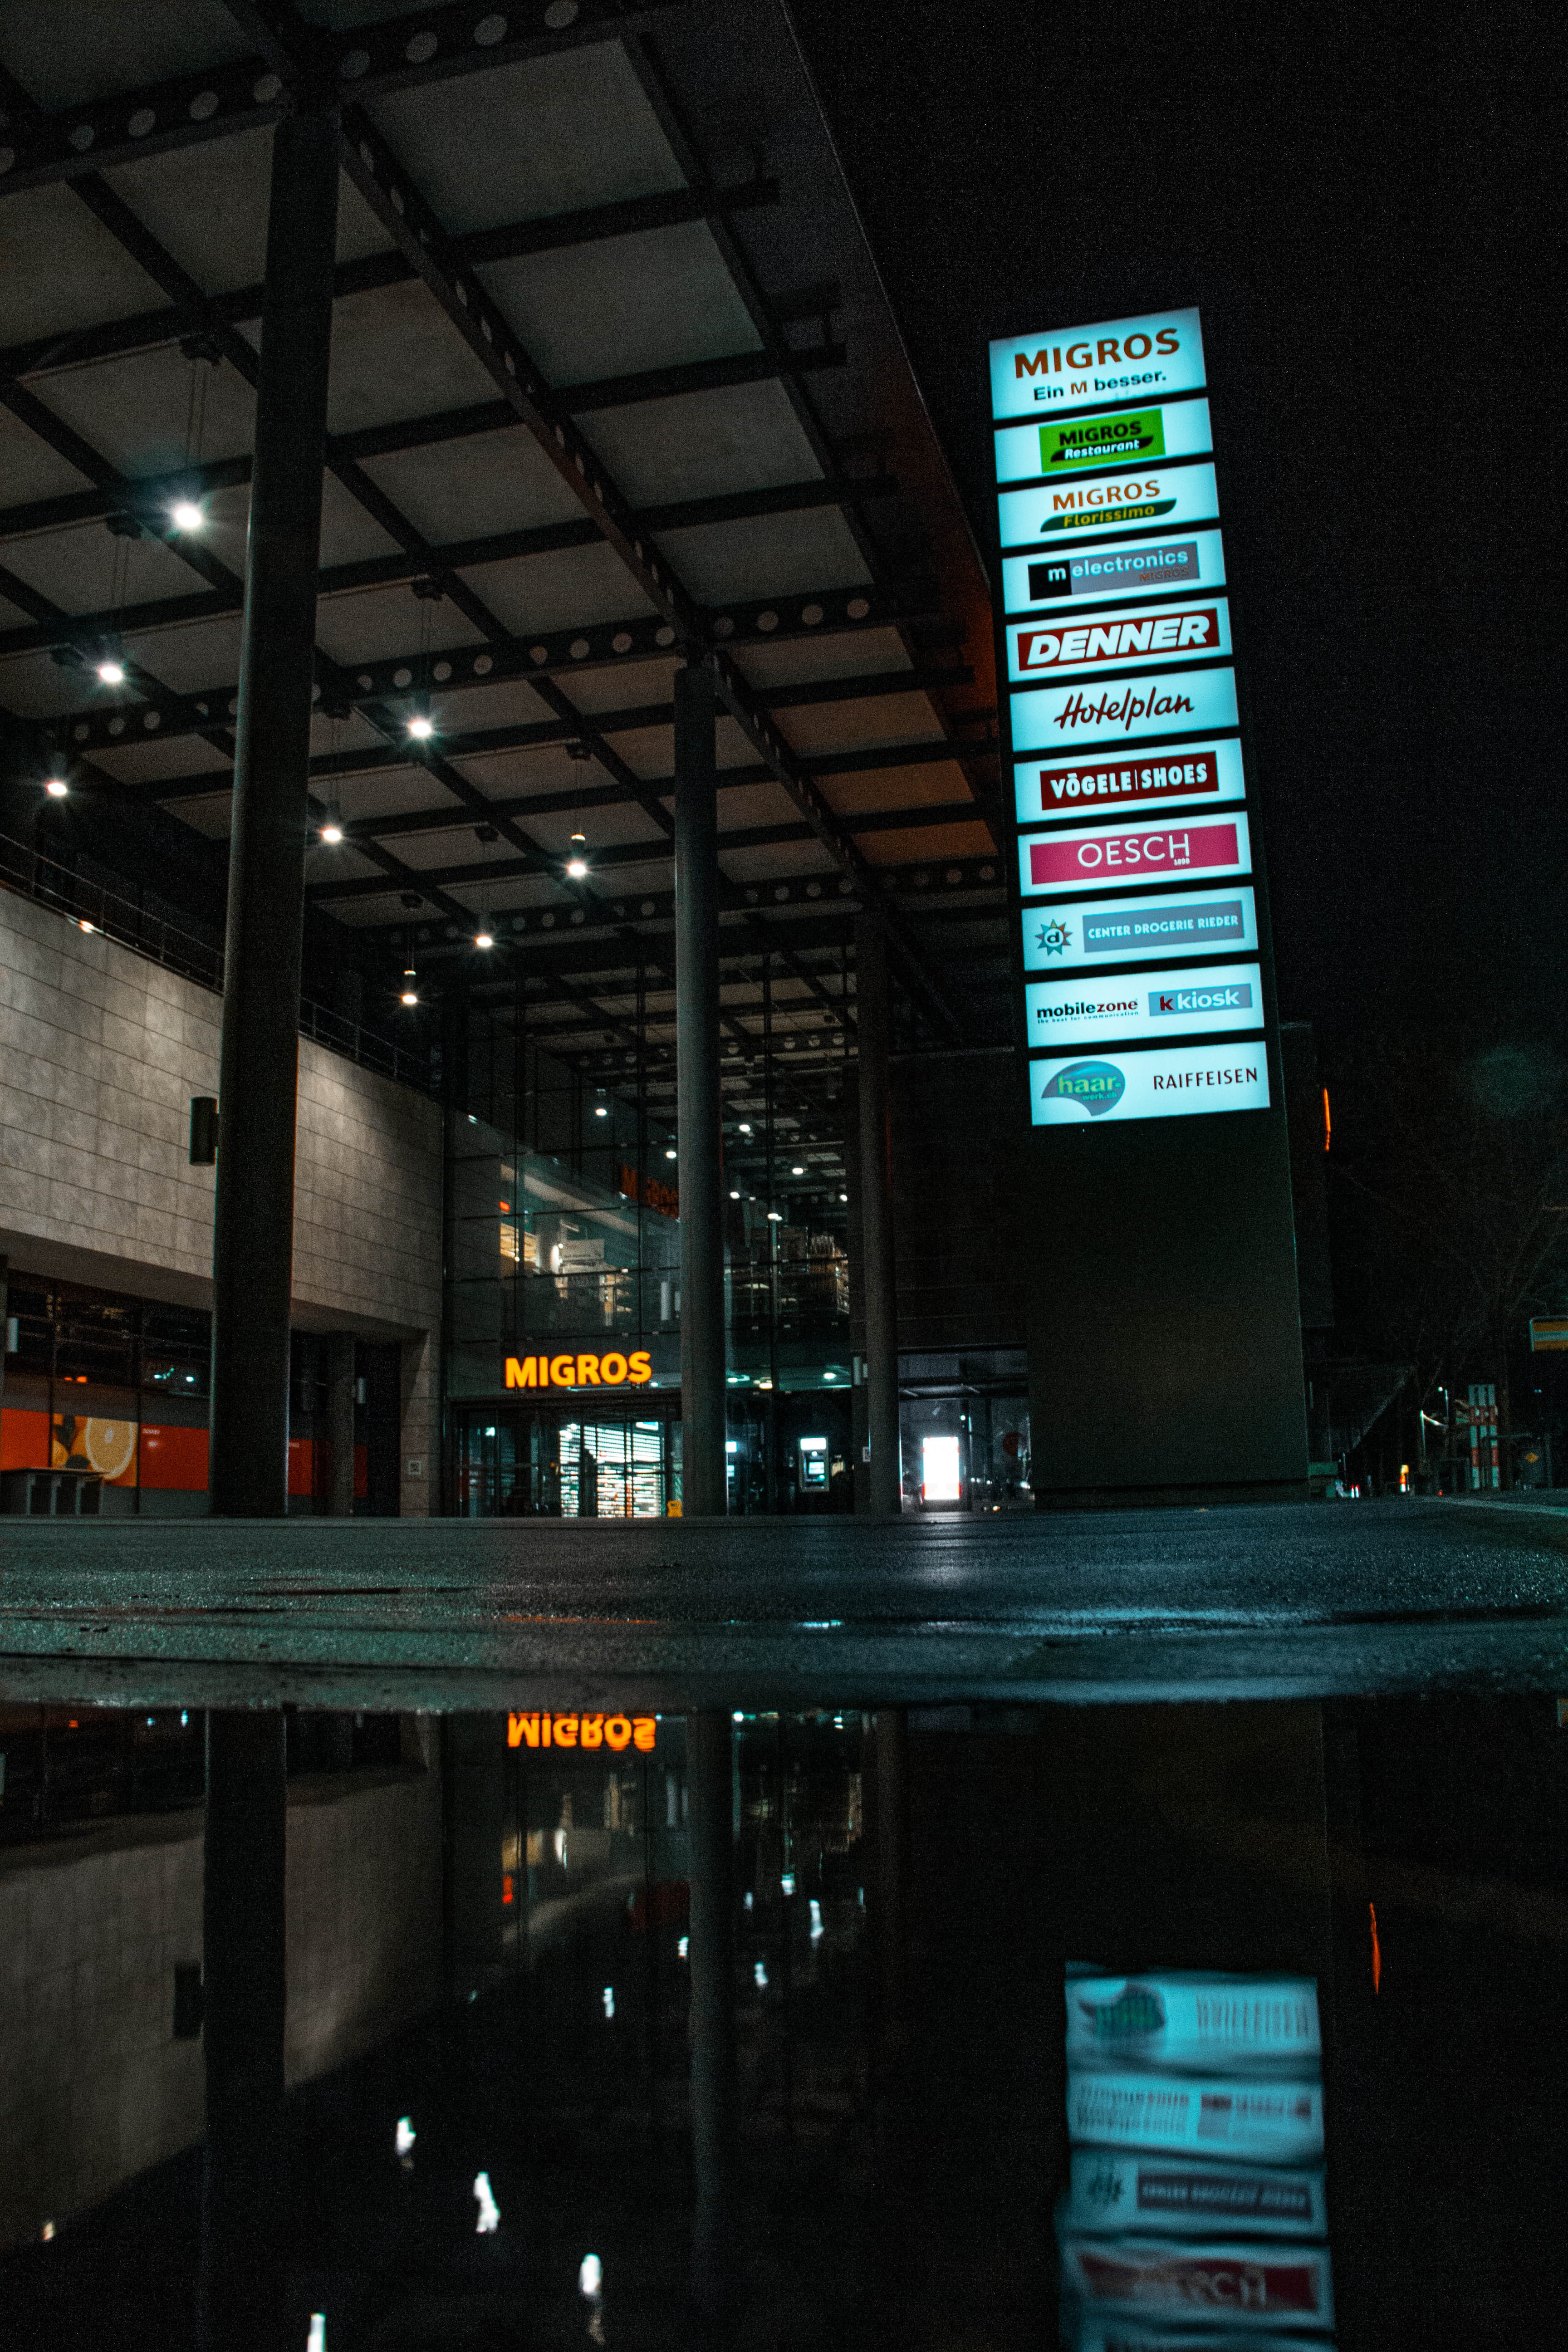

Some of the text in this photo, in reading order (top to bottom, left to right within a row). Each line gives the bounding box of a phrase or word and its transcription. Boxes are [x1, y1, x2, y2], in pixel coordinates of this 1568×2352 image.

[1014, 328, 1180, 378] MIGROS
[1034, 370, 1166, 401] Ein M besser.
[1059, 421, 1142, 446] MIGROS
[1064, 439, 1140, 460] Restaurant
[1053, 480, 1160, 510] MIGROS
[1063, 505, 1155, 528] Florissimo
[1140, 567, 1189, 580] MIGROS
[1027, 615, 1210, 665] DENNER
[1053, 686, 1195, 731] Hotelplan
[1141, 763, 1208, 789] SHOES
[1078, 833, 1190, 868] OESCH
[1088, 915, 1239, 939] CENTER DROGERIE RIEDER
[1037, 1000, 1138, 1019] mobilezone
[1159, 989, 1240, 1012] k kiosk
[1154, 1067, 1257, 1090] RAIFFEISEN
[505, 1351, 652, 1388] MIGROS
